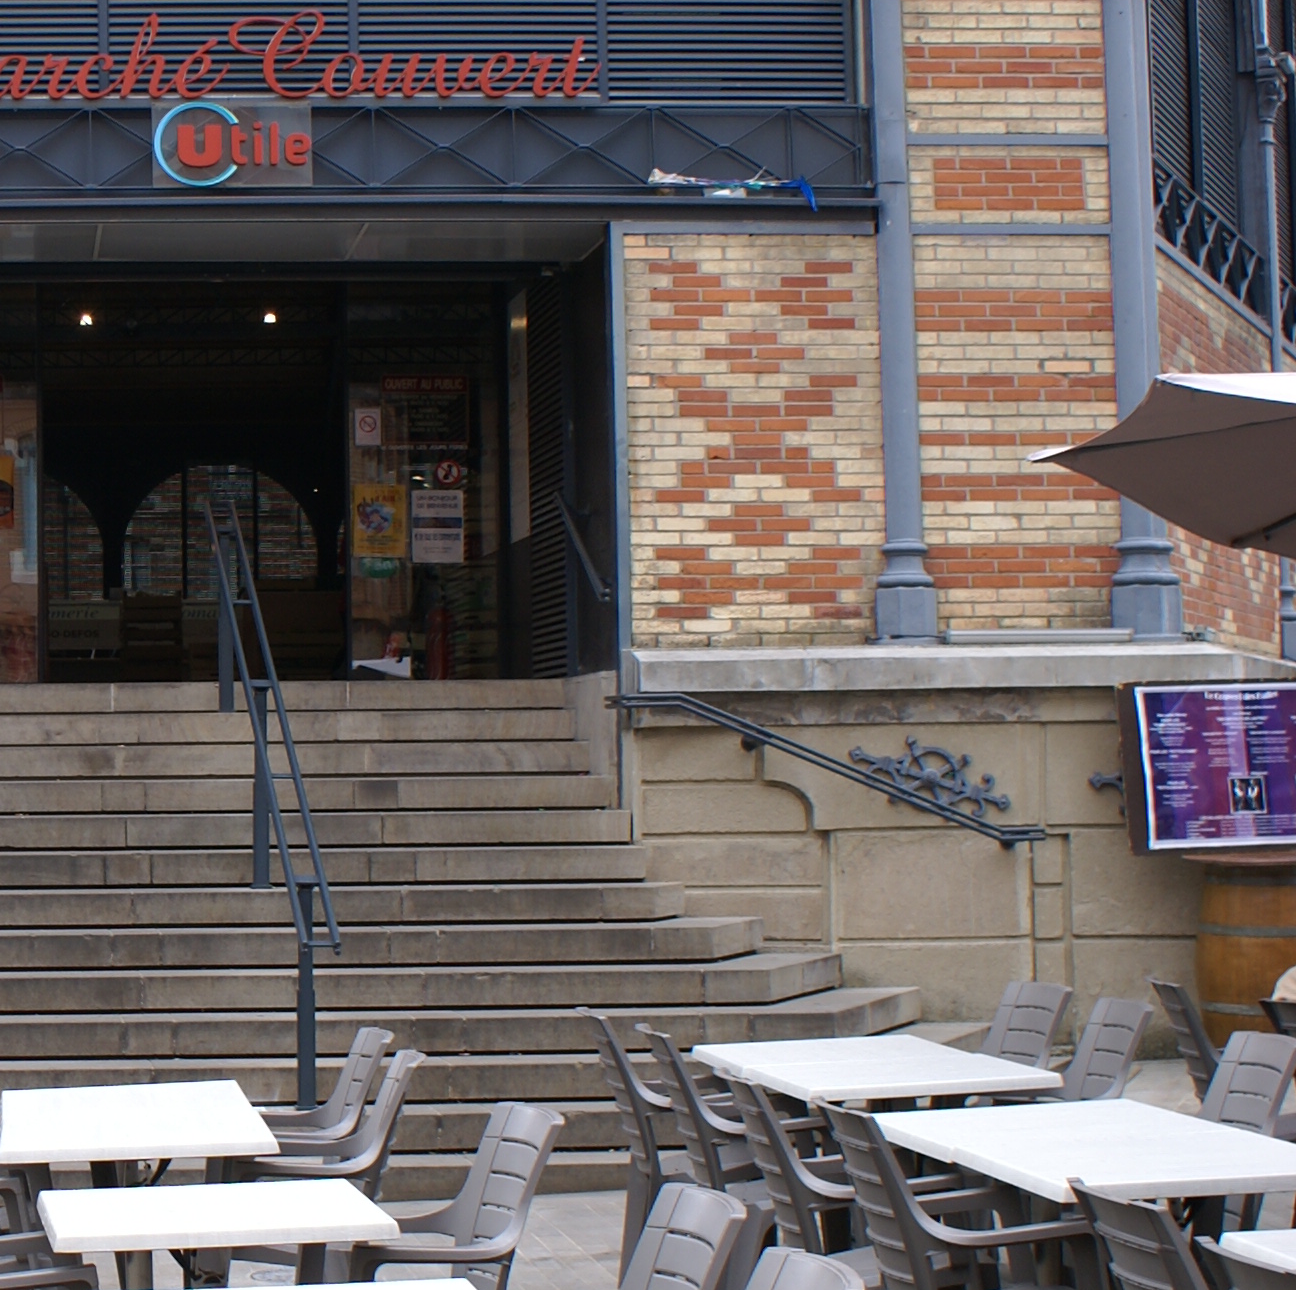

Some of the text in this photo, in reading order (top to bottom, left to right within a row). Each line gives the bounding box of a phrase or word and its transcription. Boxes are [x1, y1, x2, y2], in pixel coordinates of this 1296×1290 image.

[228, 9, 602, 99] Couvert
[385, 378, 464, 390] OUVERT AU PUBLIC
[63, 629, 100, 638] DEFOS
